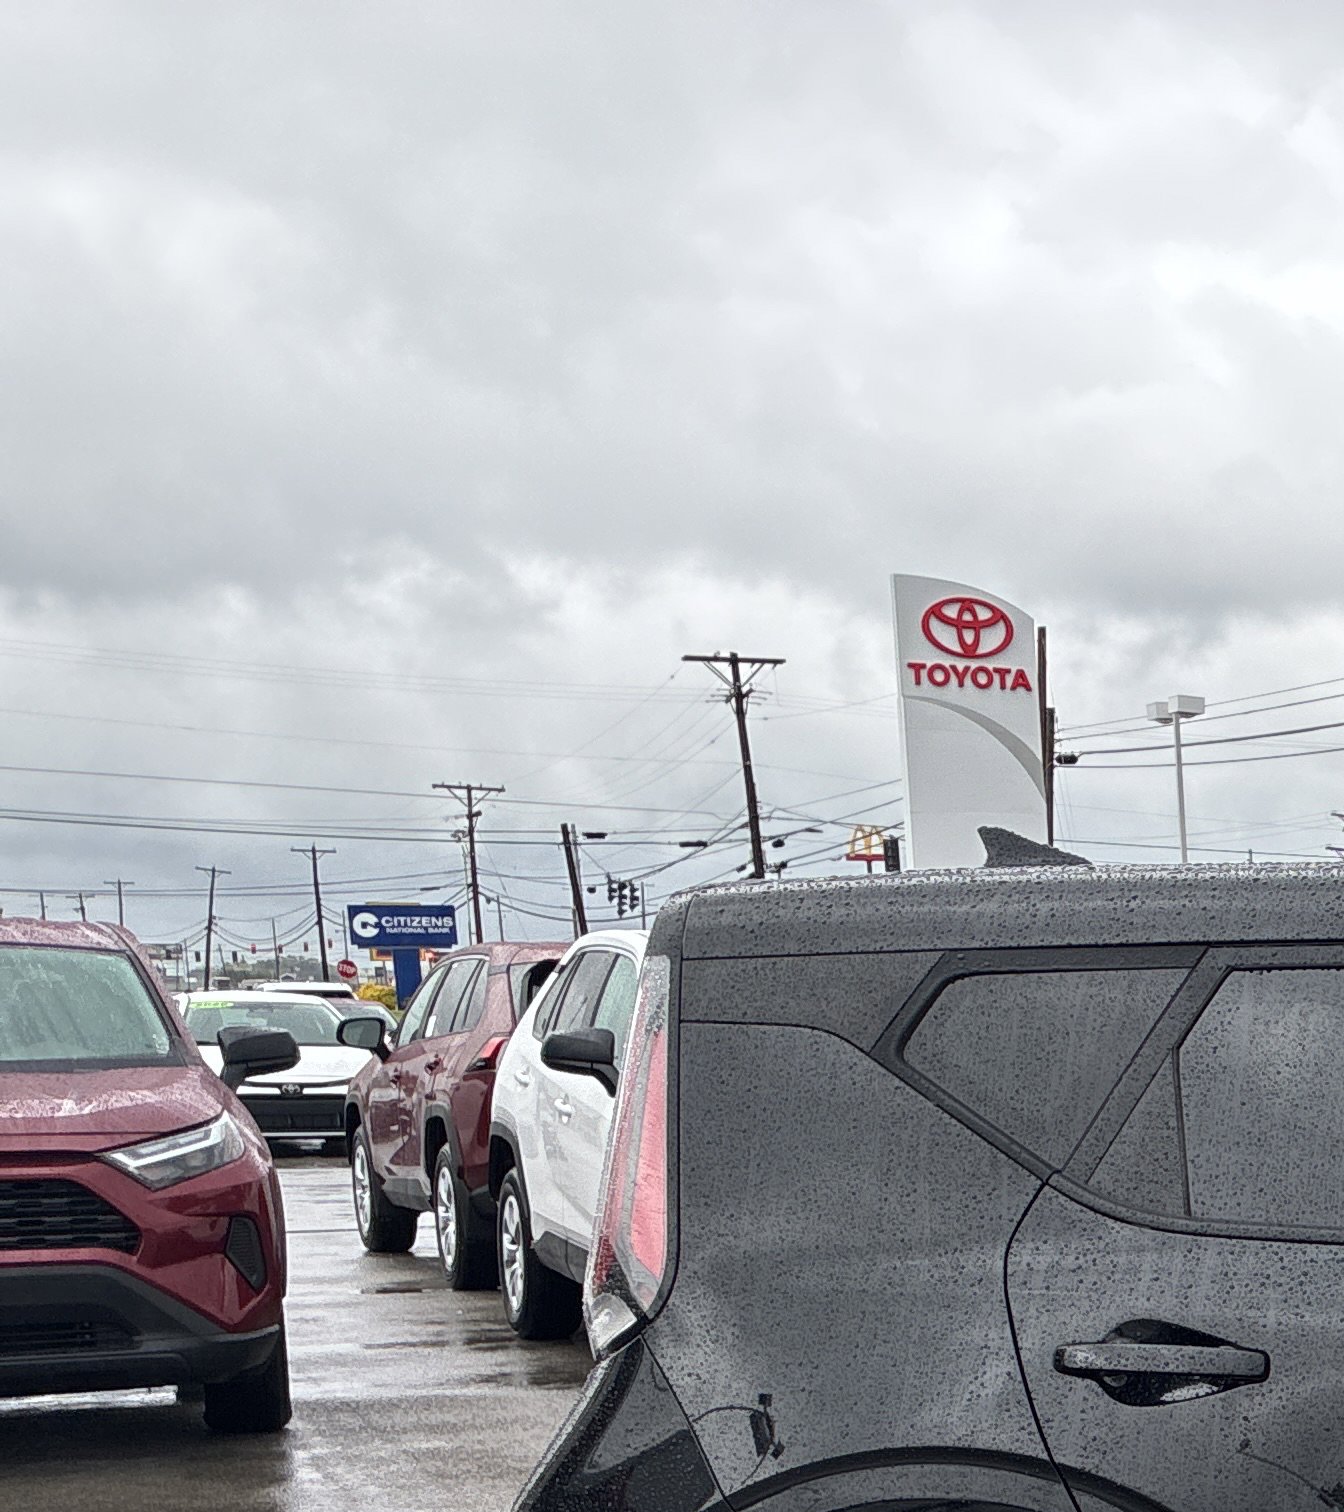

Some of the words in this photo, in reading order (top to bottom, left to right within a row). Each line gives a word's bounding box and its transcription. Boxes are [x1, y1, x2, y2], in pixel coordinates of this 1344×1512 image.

[906, 662, 1032, 692] TOYOTA
[381, 916, 454, 927] CITIZENS
[339, 964, 356, 974] STOP
